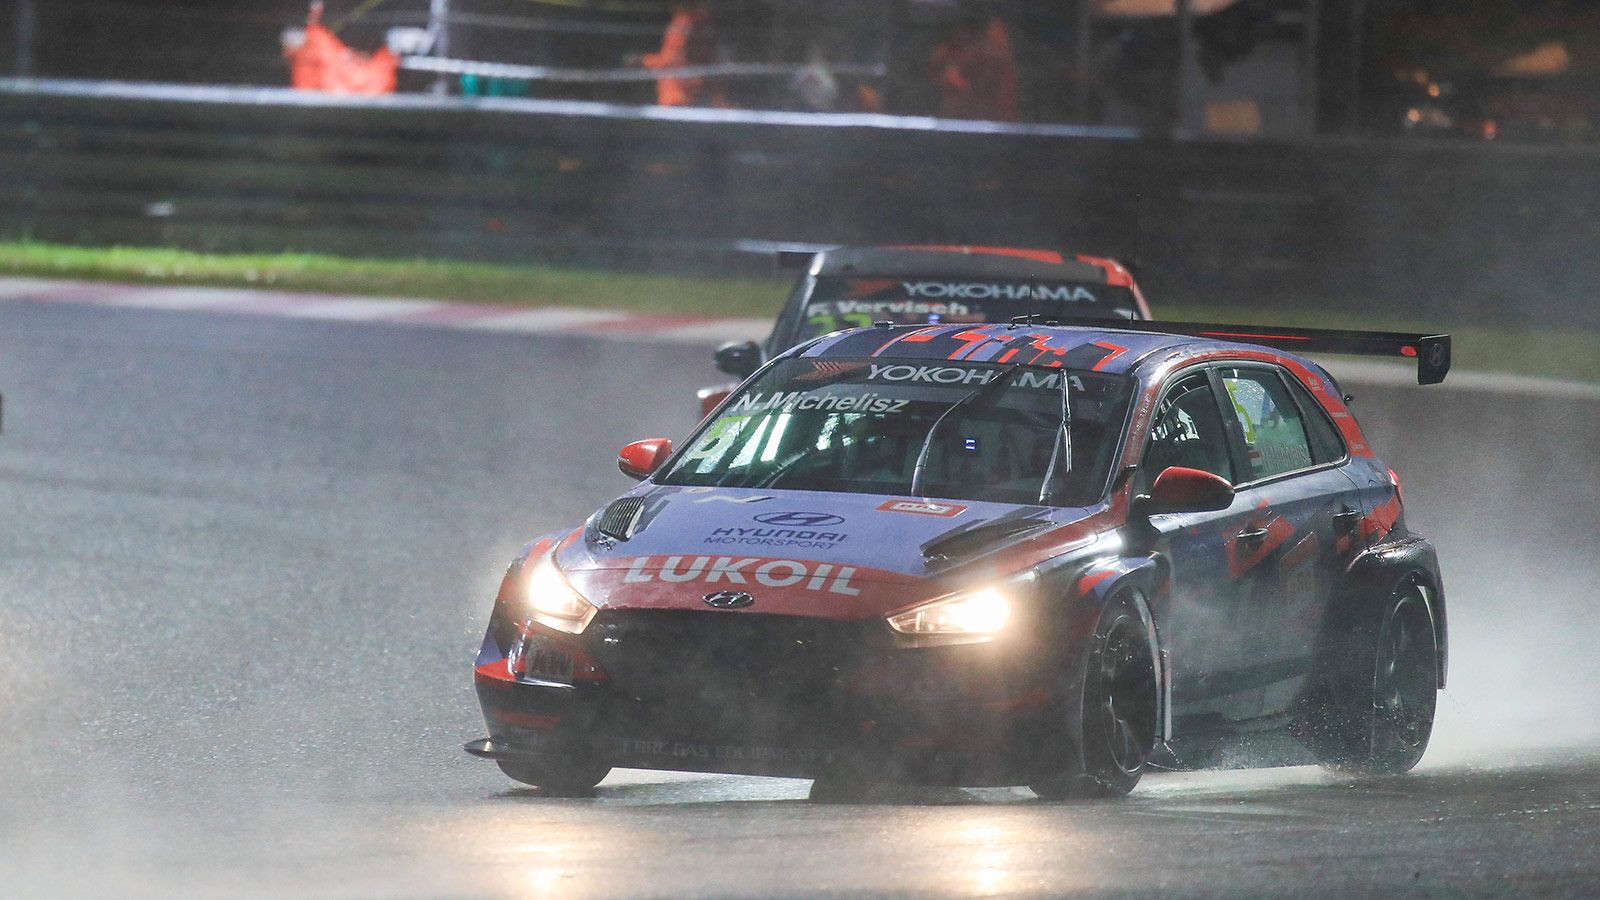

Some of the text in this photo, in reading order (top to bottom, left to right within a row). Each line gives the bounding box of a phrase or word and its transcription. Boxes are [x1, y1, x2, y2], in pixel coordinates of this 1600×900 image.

[903, 281, 1096, 303] YOKOHAMA
[837, 300, 968, 316] Vervisch
[867, 363, 1085, 392] YOKOHMA
[690, 414, 750, 460] 5
[702, 536, 842, 550] MOTORSPORT
[711, 527, 849, 543] HYUNDAI
[623, 556, 861, 597] LUKOIL
